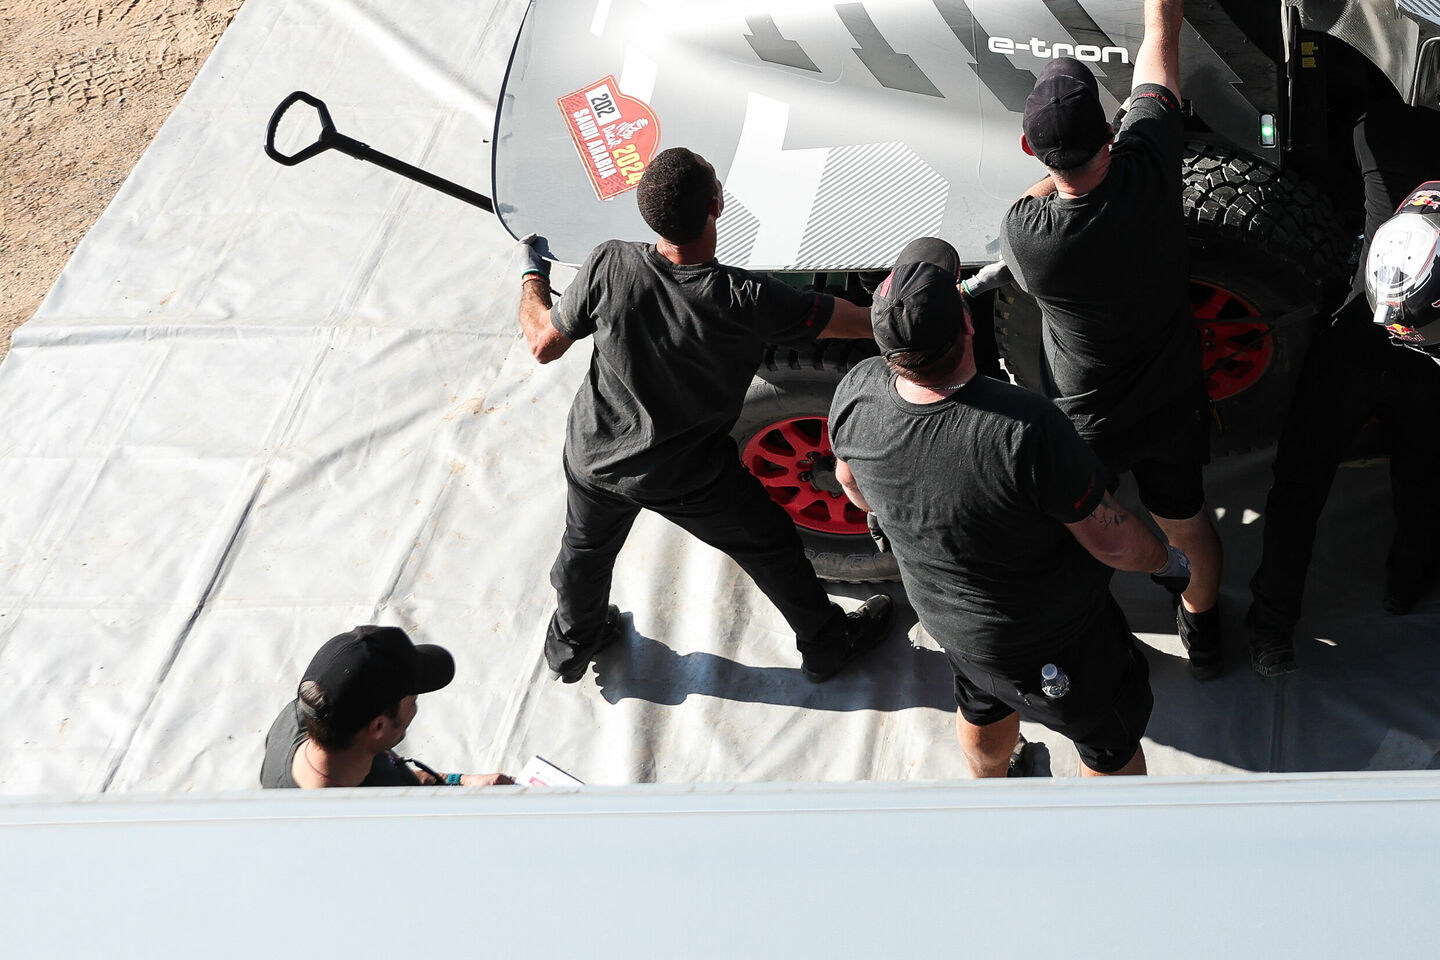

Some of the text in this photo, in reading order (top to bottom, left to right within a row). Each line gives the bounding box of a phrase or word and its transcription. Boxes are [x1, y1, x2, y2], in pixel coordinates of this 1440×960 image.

[987, 36, 1129, 64] e-tron
[590, 93, 616, 118] 202
[572, 107, 618, 180] SAUDI ARABIA
[611, 143, 645, 185] 2024
